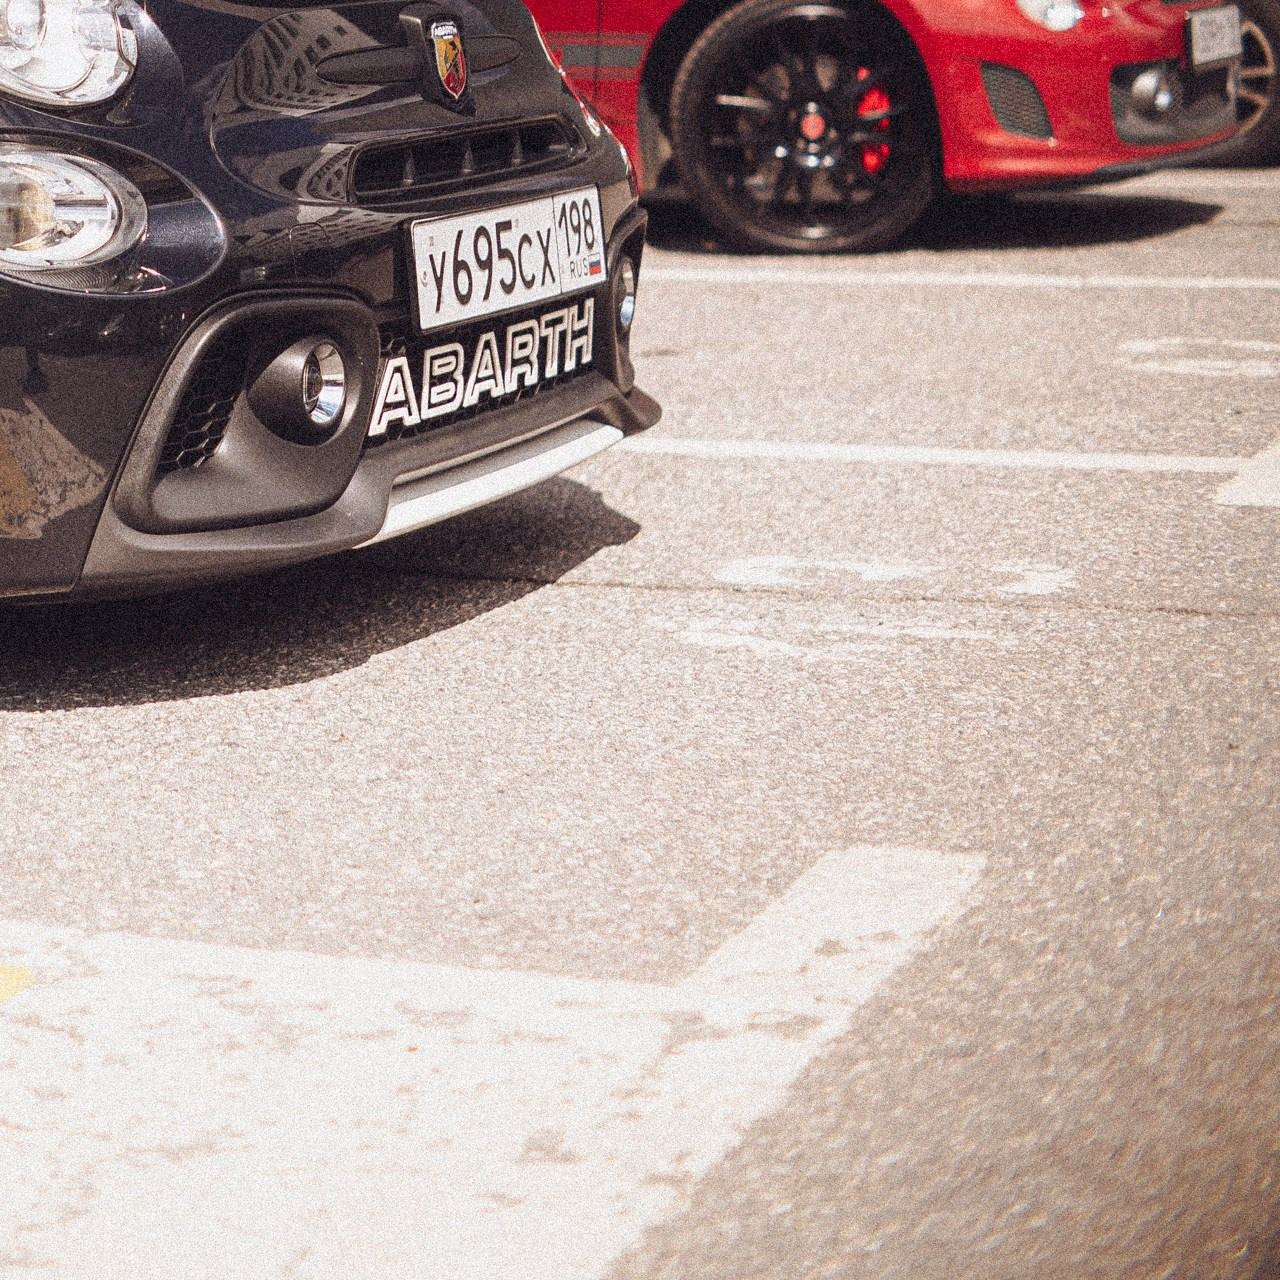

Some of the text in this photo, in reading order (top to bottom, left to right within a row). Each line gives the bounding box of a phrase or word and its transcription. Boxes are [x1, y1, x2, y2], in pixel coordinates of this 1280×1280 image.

[558, 197, 595, 257] 198
[569, 257, 589, 280] RUS
[368, 297, 595, 437] ABARTH
